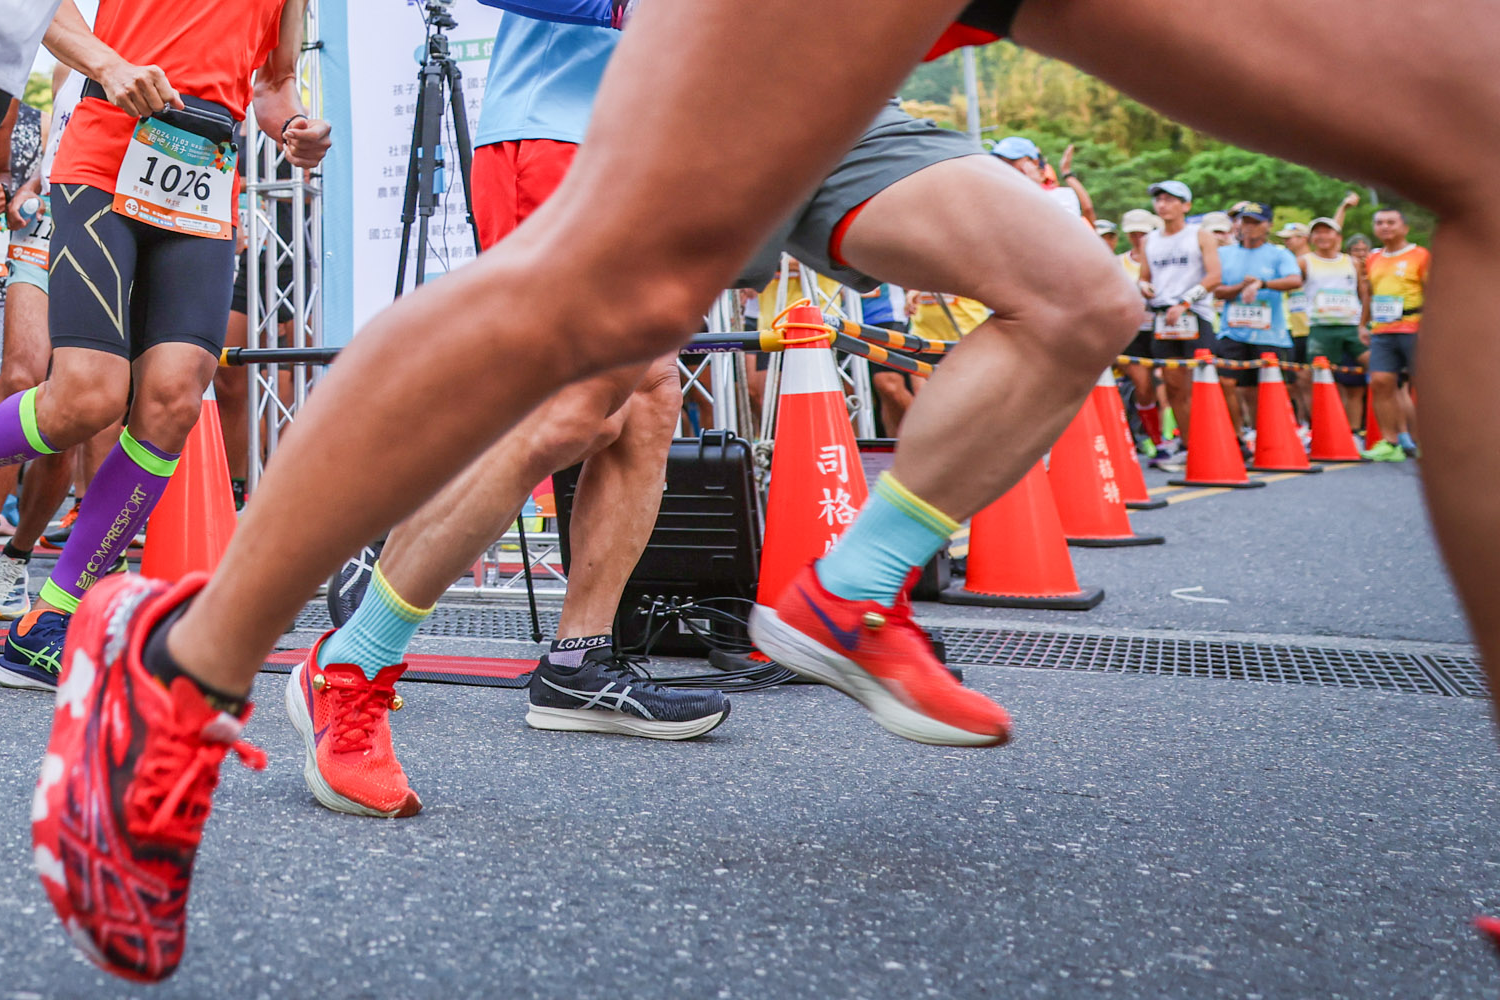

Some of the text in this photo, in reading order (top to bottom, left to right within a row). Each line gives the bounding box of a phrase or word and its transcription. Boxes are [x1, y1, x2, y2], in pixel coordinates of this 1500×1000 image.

[139, 156, 211, 201] 1026
[126, 203, 137, 211] 42
[557, 635, 606, 650] Lohas
